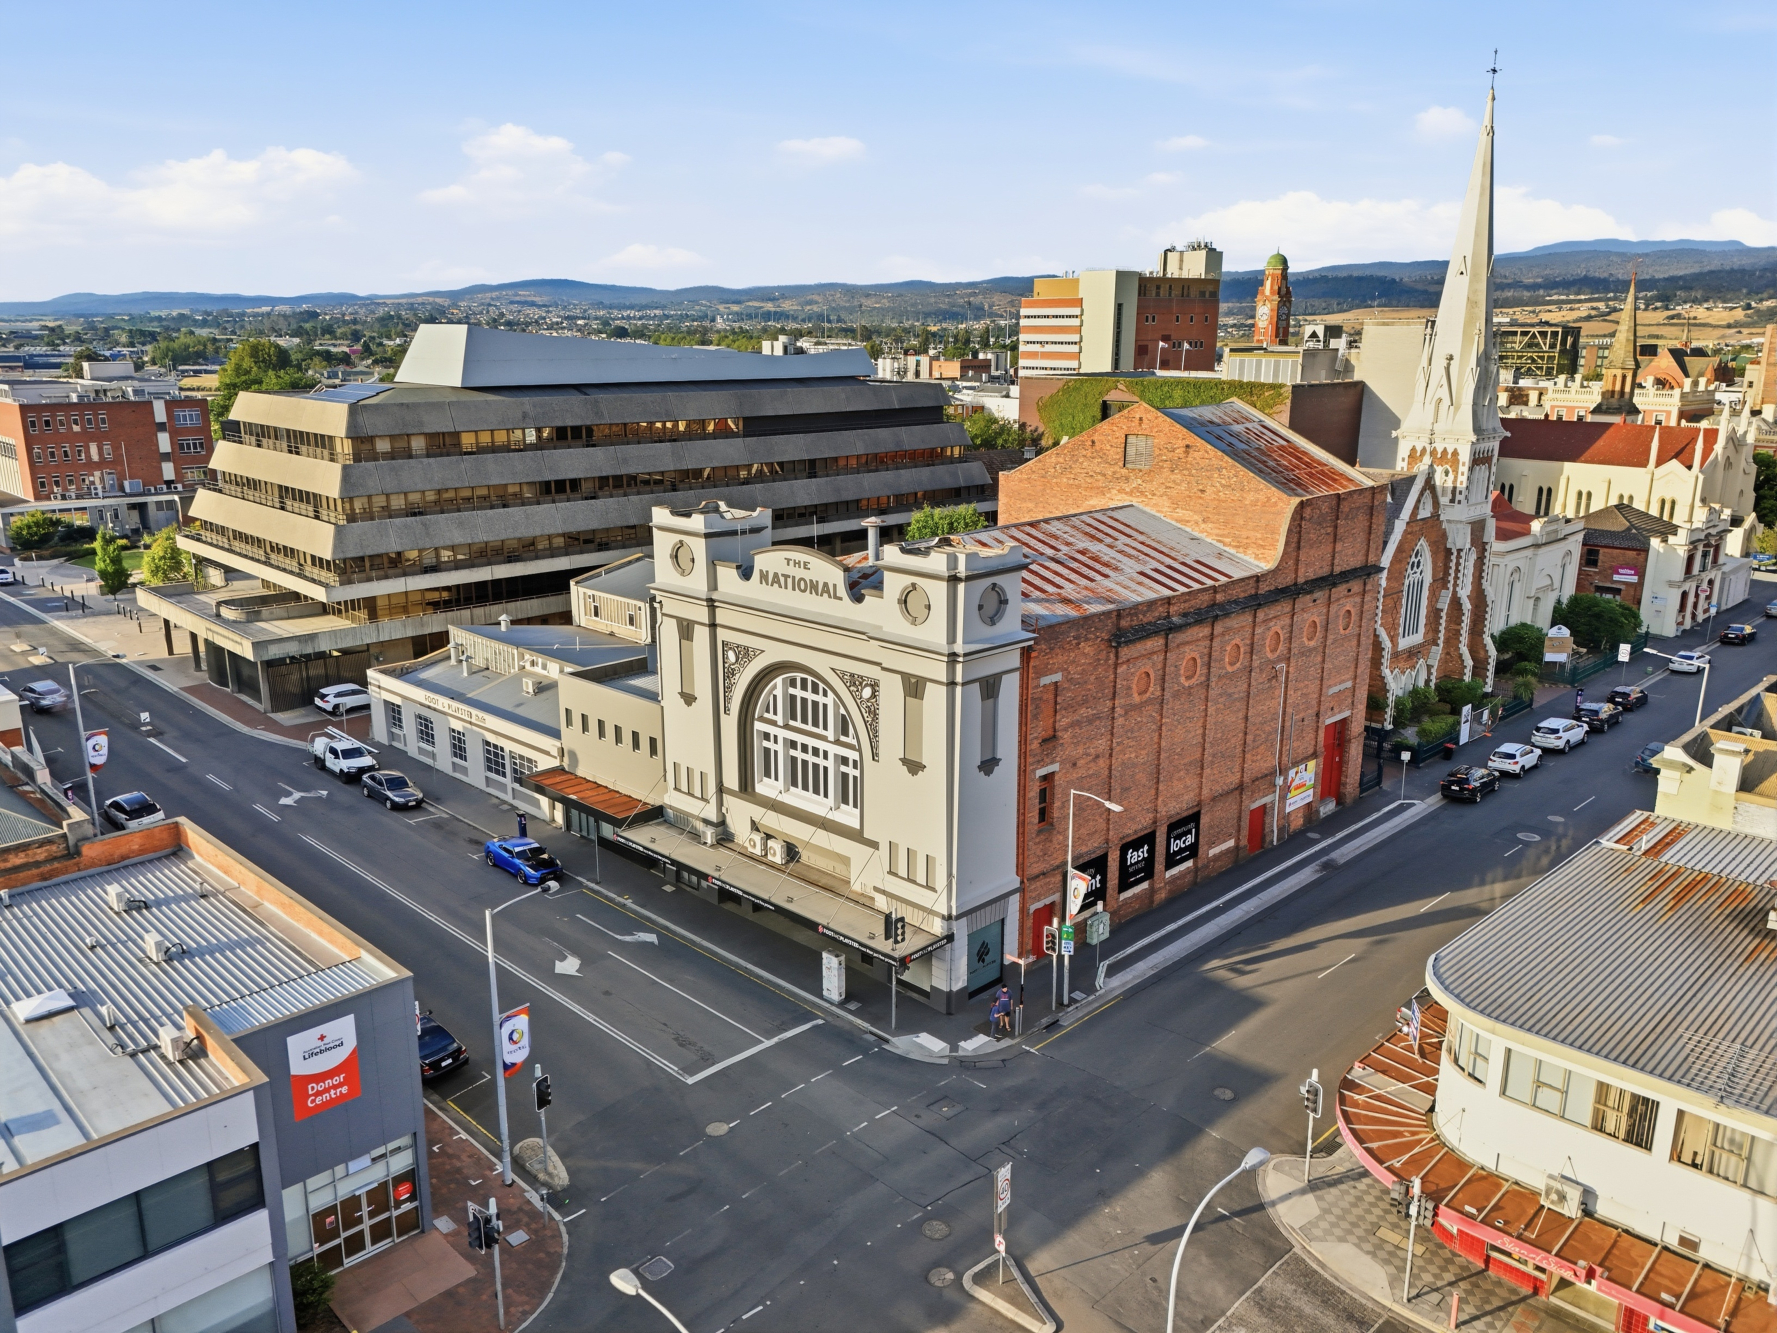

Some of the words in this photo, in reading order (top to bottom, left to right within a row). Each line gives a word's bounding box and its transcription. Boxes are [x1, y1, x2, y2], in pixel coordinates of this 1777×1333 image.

[784, 557, 811, 571] THE
[758, 568, 844, 602] NATIONAL
[424, 694, 440, 707] FOOT
[447, 703, 473, 720] PLAYSTED
[1170, 822, 1196, 838] community
[1170, 828, 1196, 854] local
[1126, 844, 1149, 866] fast
[1128, 860, 1146, 874] service
[303, 1040, 344, 1061] Lifeblood
[307, 1073, 346, 1095] Donor
[307, 1085, 348, 1107] Centre
